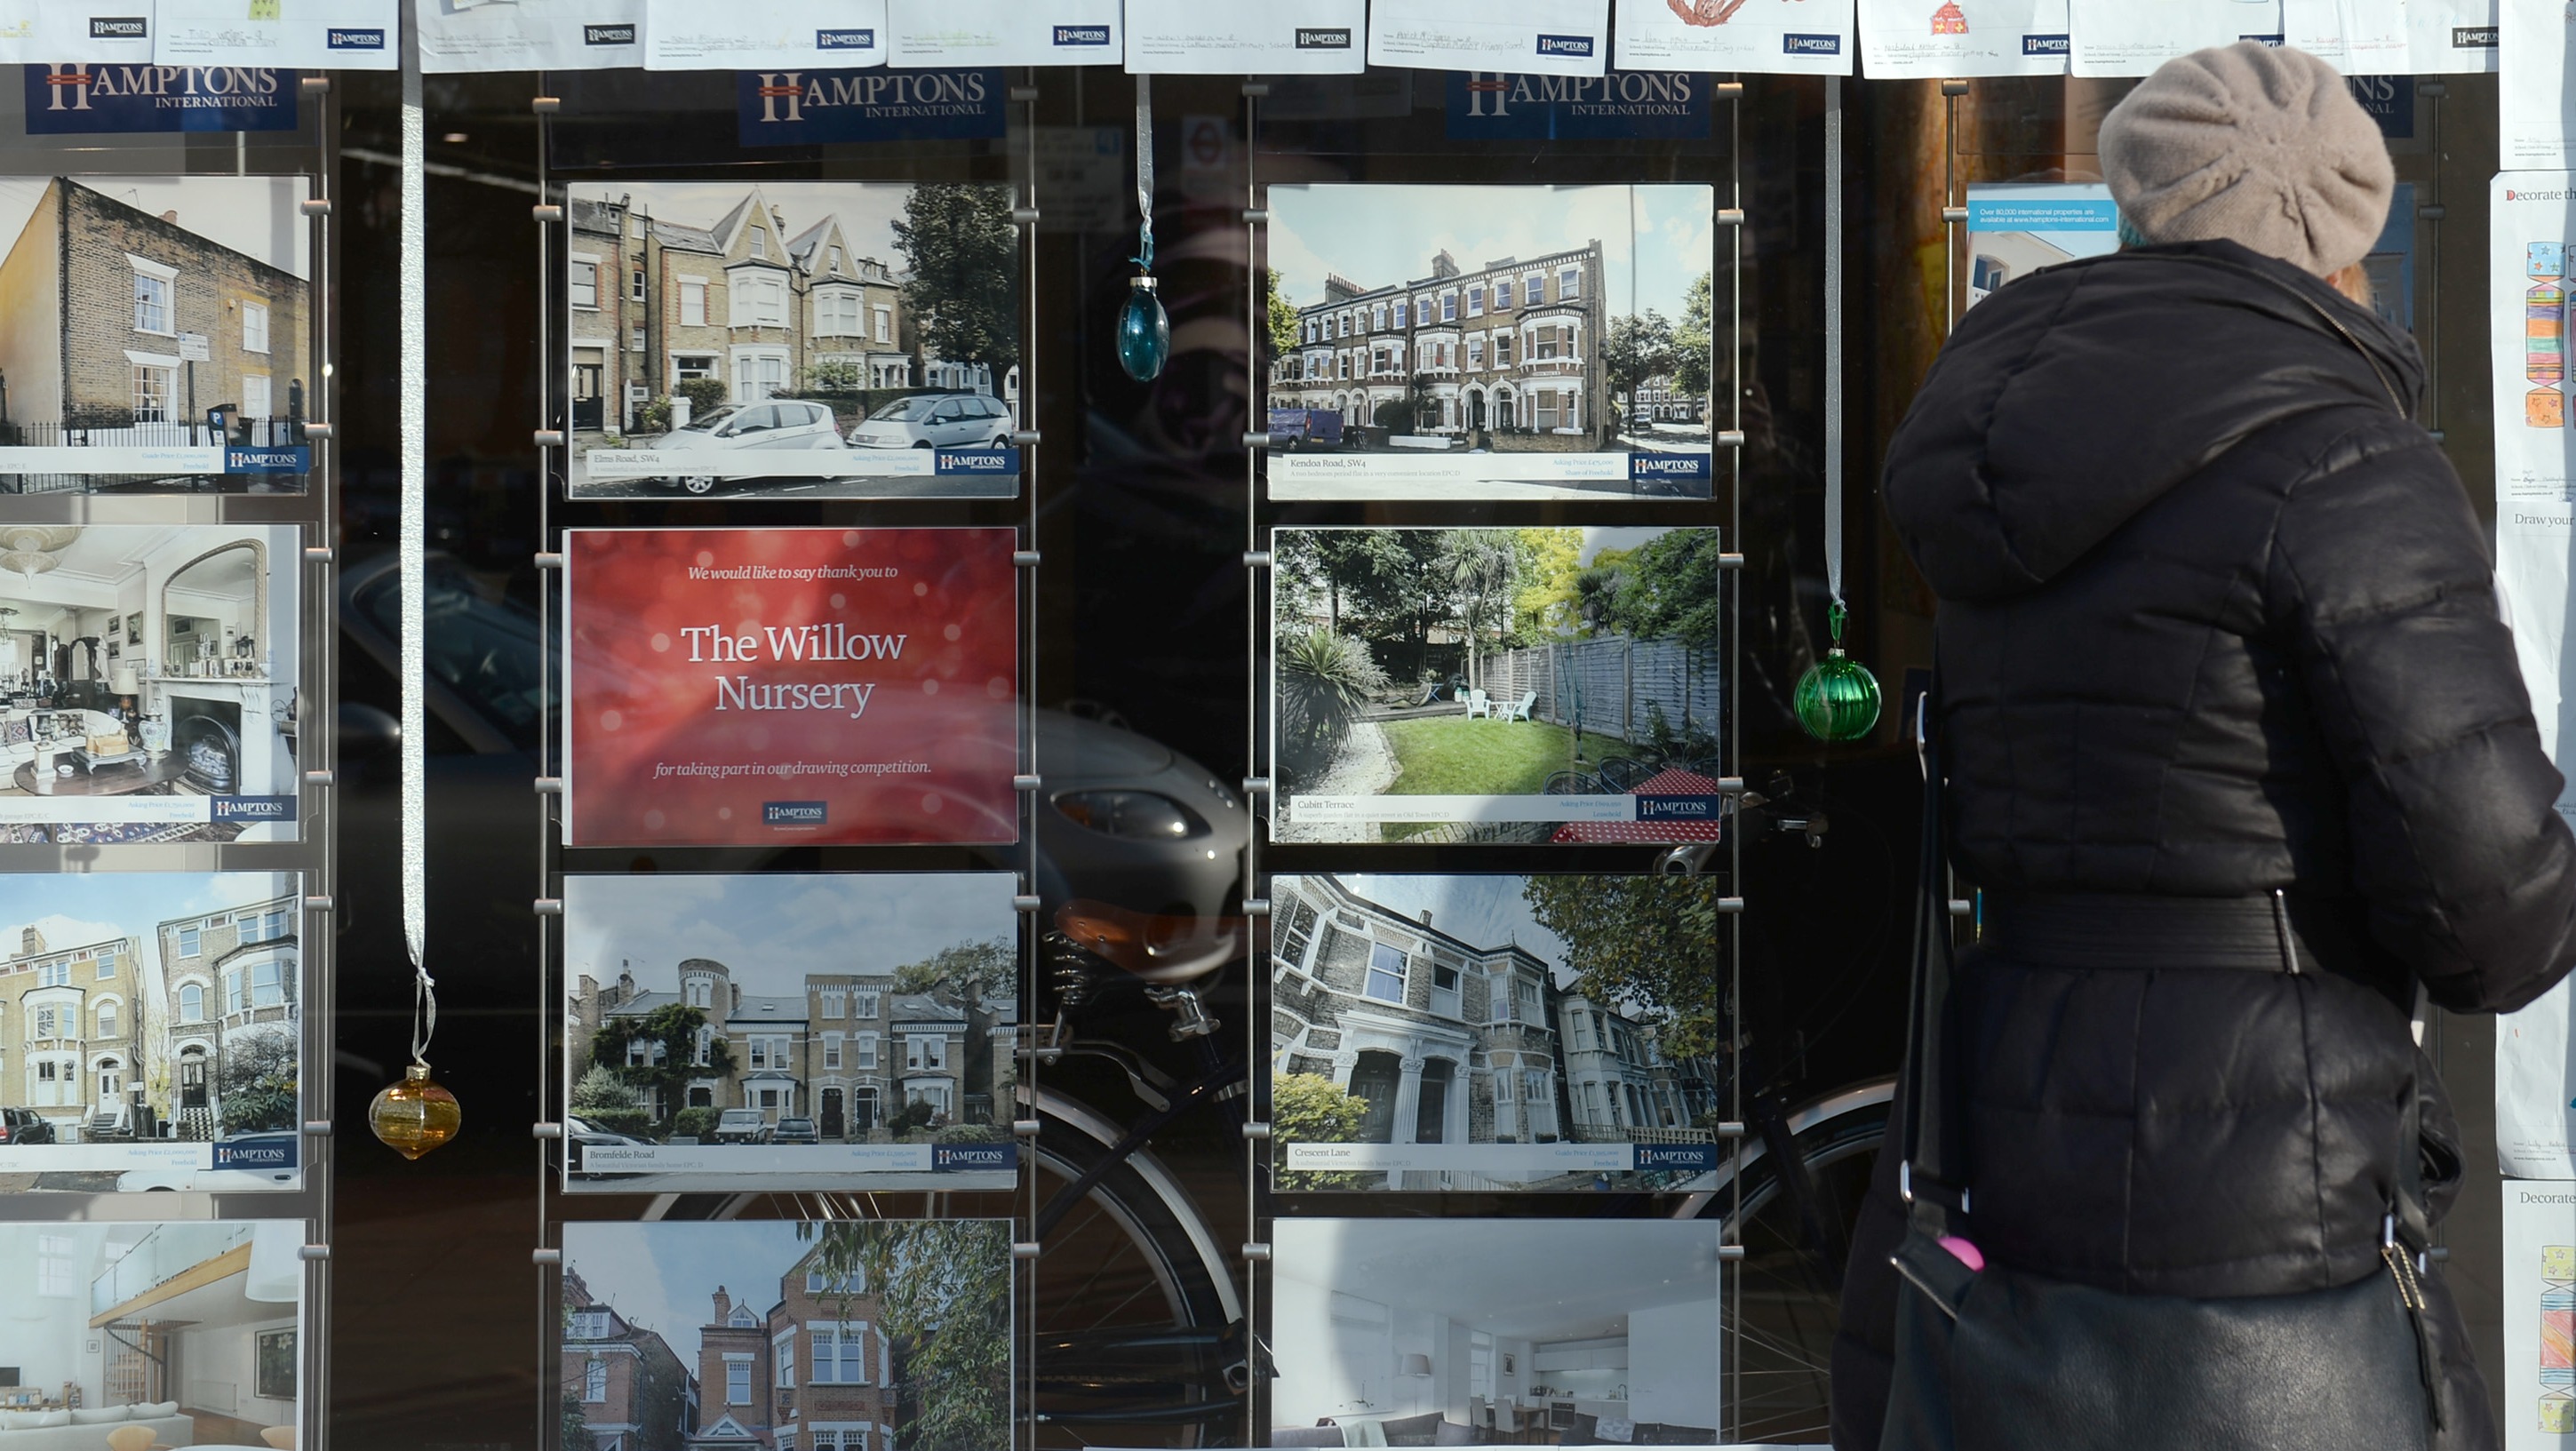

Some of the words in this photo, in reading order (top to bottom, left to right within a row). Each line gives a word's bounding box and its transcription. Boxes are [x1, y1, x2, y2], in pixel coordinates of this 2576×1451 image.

[93, 21, 143, 34] HAMPTONS
[331, 32, 381, 44] HAMPTONS
[821, 33, 871, 45] HAMPTONS
[1057, 29, 1106, 42] HAMPTONS
[1300, 32, 1347, 44] HAMPTONS
[2457, 32, 2499, 44] HAMPTON
[1542, 38, 1590, 51] HAMPTONS
[1789, 37, 1836, 50] HAMPTONS
[2027, 39, 2070, 51] HAMPTON
[46, 63, 277, 110] HAMPTONS
[1466, 70, 1691, 116] HAMPTONS
[156, 97, 277, 108] INTERNATIONAL
[758, 73, 985, 122] HAMPTONS
[865, 104, 985, 118] INTERNATIONAL
[1572, 104, 1690, 116] INTERNATIONAL
[2506, 189, 2562, 201] Decorate
[230, 452, 296, 467] HAMPTONS
[594, 454, 614, 464] Elms
[616, 454, 639, 464] Road,
[641, 454, 660, 464] SW4
[940, 454, 1005, 469] HAMPTONS
[1290, 459, 1321, 468] Kendoa
[1323, 459, 1346, 468] Road,
[1347, 459, 1366, 468] SW4
[1635, 458, 1699, 474] HAMPTONS
[2515, 513, 2546, 525] Draw
[2548, 517, 2574, 528] your
[688, 566, 710, 580] We
[711, 566, 751, 580] would
[752, 565, 777, 579] like
[778, 567, 792, 579] to
[794, 569, 816, 582] say
[817, 564, 857, 579] thank
[857, 569, 883, 582] you
[884, 566, 898, 578] to
[681, 625, 758, 662] The
[763, 623, 907, 662] Willow
[714, 675, 875, 719] Nursery
[653, 761, 674, 779] for
[676, 761, 721, 779] taking
[721, 761, 752, 778] part
[752, 762, 765, 776] in
[767, 764, 793, 776] our
[793, 761, 849, 778] drawing
[850, 760, 932, 778] competition.
[216, 801, 283, 816] HAMPTONS
[1298, 800, 1323, 809] Cubitt
[1325, 800, 1354, 809] Terrace
[1643, 800, 1707, 815] HAMPTONS
[769, 807, 822, 820] HAMPTONS
[218, 1148, 285, 1163] HAMPTONS
[590, 1150, 632, 1159] Bromfelde
[634, 1150, 655, 1159] Road
[938, 1149, 1003, 1164] HAMPTONS
[1295, 1148, 1329, 1157] Crescent
[1331, 1148, 1351, 1157] Lane
[1640, 1149, 1704, 1164] HAMPTONS
[2520, 1192, 2576, 1204] Decorate
